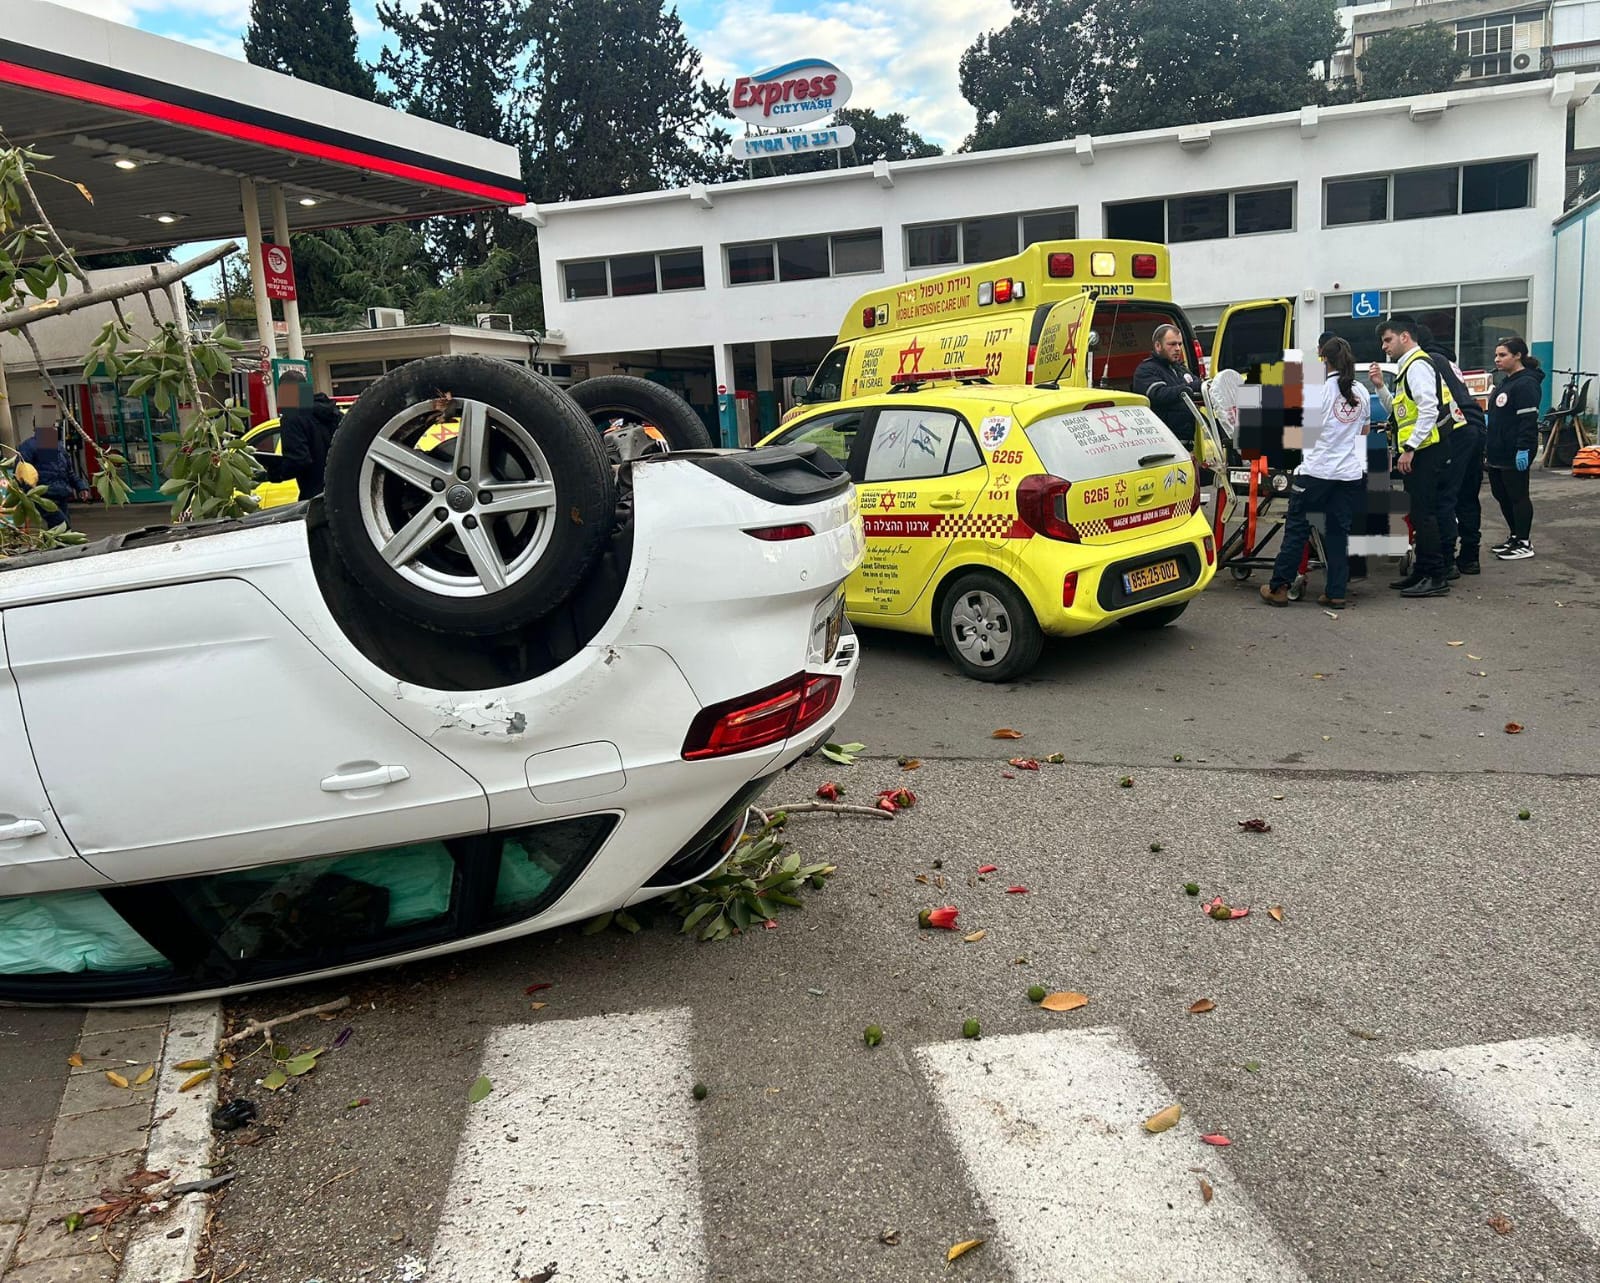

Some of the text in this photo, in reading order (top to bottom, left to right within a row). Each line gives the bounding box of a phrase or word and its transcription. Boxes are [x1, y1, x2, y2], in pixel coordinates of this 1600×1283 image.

[733, 74, 838, 117] Express
[772, 99, 833, 115] CITYWASH
[745, 130, 838, 154] רכב נקי תמיד!
[919, 282, 944, 298] טיפול
[947, 276, 971, 293] ניידת
[896, 294, 971, 320] MOBILE INTENSIVE CARE UNIT
[940, 334, 968, 350] מגן דוד
[984, 327, 1013, 347] ירקון
[864, 347, 885, 358] MAGEN
[943, 350, 966, 365] אדום
[861, 358, 879, 369] DAVID
[985, 351, 1003, 376] 333
[859, 377, 883, 389] IN ISRAEL
[1062, 416, 1089, 426] MAGEN
[1067, 423, 1090, 433] DAVID
[1073, 429, 1096, 440] ADOM
[1077, 433, 1111, 447] IN ISRAEL
[992, 450, 1024, 464] 6265
[988, 490, 1009, 500] 101
[1083, 487, 1109, 505] 6265
[1113, 497, 1129, 508] 101
[873, 519, 903, 531] ההצלה
[906, 520, 930, 533] ארגון
[1112, 517, 1129, 528] MAGEN
